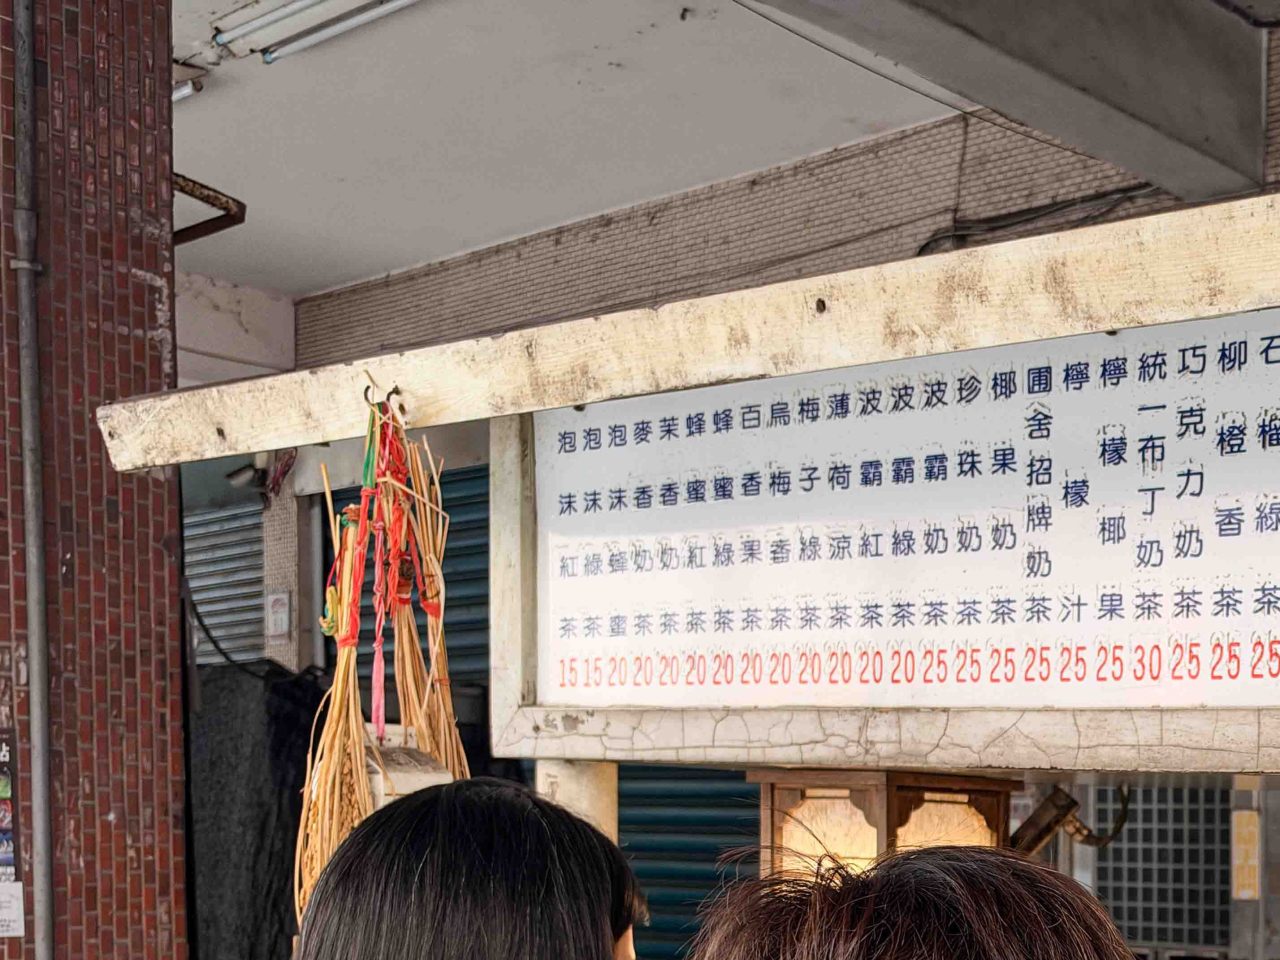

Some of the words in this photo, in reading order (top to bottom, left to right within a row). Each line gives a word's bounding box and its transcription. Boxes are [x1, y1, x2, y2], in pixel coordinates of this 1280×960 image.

[1060, 362, 1090, 623] 檸檬汁
[1097, 357, 1128, 621] 檸檬椰果
[1135, 352, 1167, 619] 統一布丁奶茶
[1174, 345, 1206, 618] 巧克力奶茶
[1213, 342, 1248, 618] 柳橙香茶
[798, 398, 821, 629] 梅子綠茶
[828, 393, 852, 629] 薄荷涼茶
[859, 389, 883, 628] 波霸紅茶
[891, 385, 915, 627] 波霸綠茶
[924, 381, 948, 626] 波霸奶茶
[957, 377, 981, 625] 珍珠奶茶
[991, 372, 1017, 625] 椰果奶茶
[559, 659, 577, 687] 15
[584, 658, 602, 687] 15
[608, 658, 627, 686] 20
[633, 657, 652, 686] 20
[660, 656, 679, 686] 20
[685, 656, 706, 685] 20
[713, 655, 734, 685] 20
[741, 653, 762, 685] 20
[769, 653, 791, 685] 20
[798, 652, 821, 684] 20
[829, 651, 852, 685] 20
[859, 650, 883, 684] 20
[891, 650, 915, 684] 20
[923, 649, 947, 684] 25
[956, 648, 981, 683] 25
[990, 647, 1016, 683] 25
[1024, 646, 1050, 682] 25
[1060, 646, 1087, 682] 25
[1096, 645, 1123, 682] 25
[1133, 644, 1162, 681] 30
[1171, 642, 1200, 680] 25
[1210, 642, 1241, 680] 25
